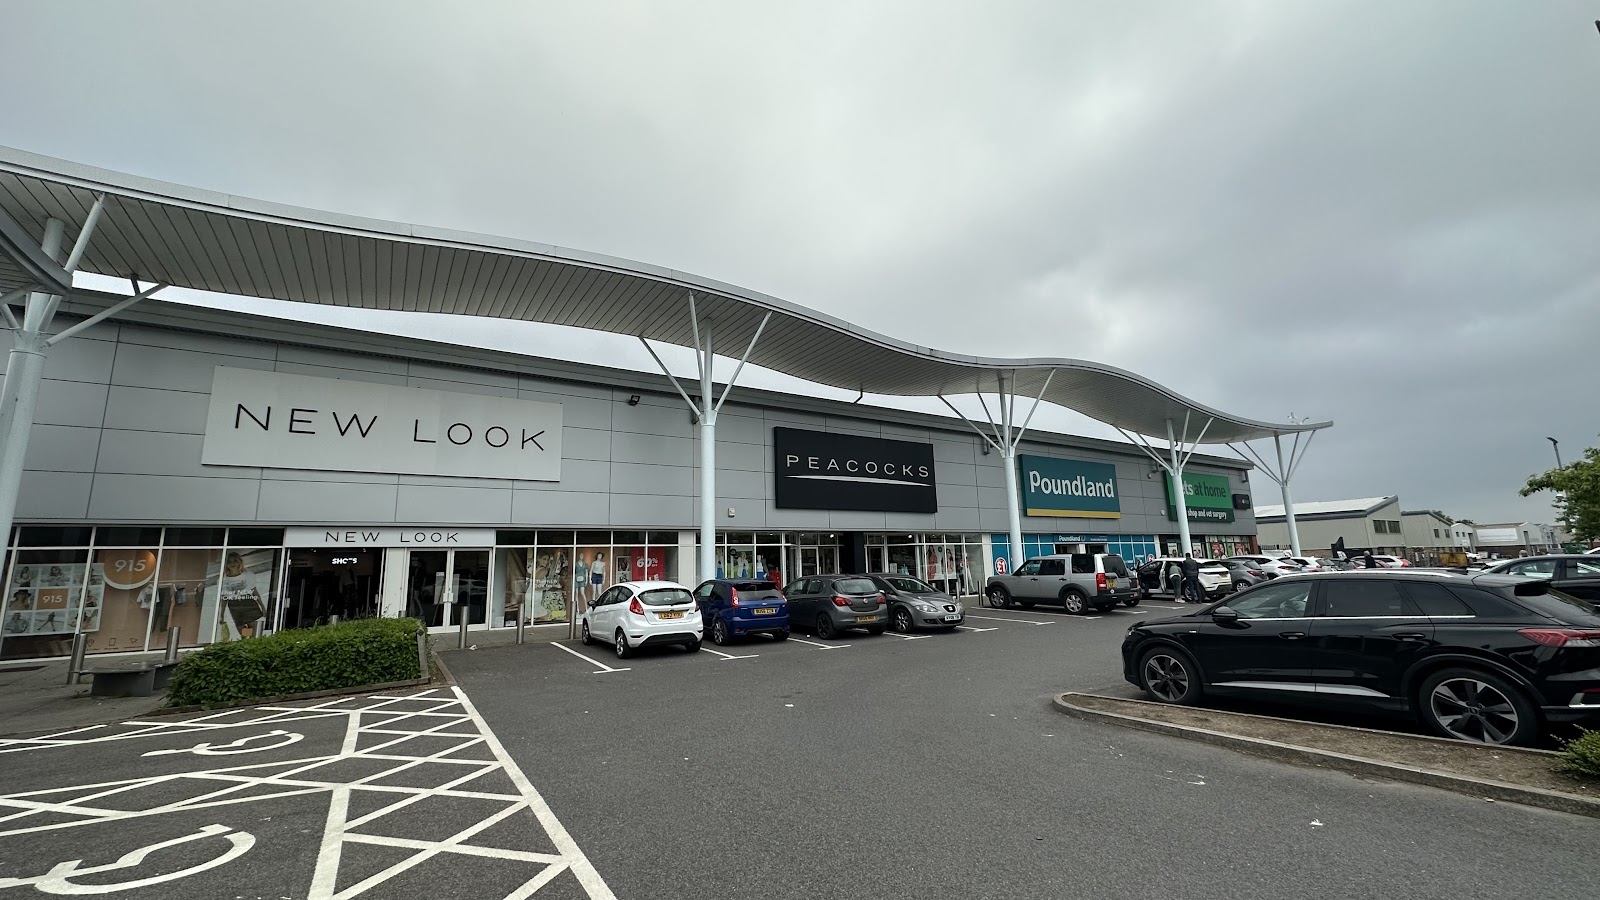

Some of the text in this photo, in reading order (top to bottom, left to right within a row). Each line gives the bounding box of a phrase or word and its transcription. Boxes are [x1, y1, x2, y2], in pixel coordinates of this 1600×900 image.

[235, 403, 546, 451] NEW LOOK
[786, 454, 929, 478] PEACOCKS
[1029, 470, 1115, 498] Poundland
[1183, 480, 1226, 498] ts at home
[1188, 508, 1198, 518] shop
[1198, 509, 1206, 517] and
[1212, 511, 1227, 520] surgery
[325, 531, 459, 542] NEW LOOK
[114, 559, 147, 572] 915
[42, 595, 63, 604] 915
